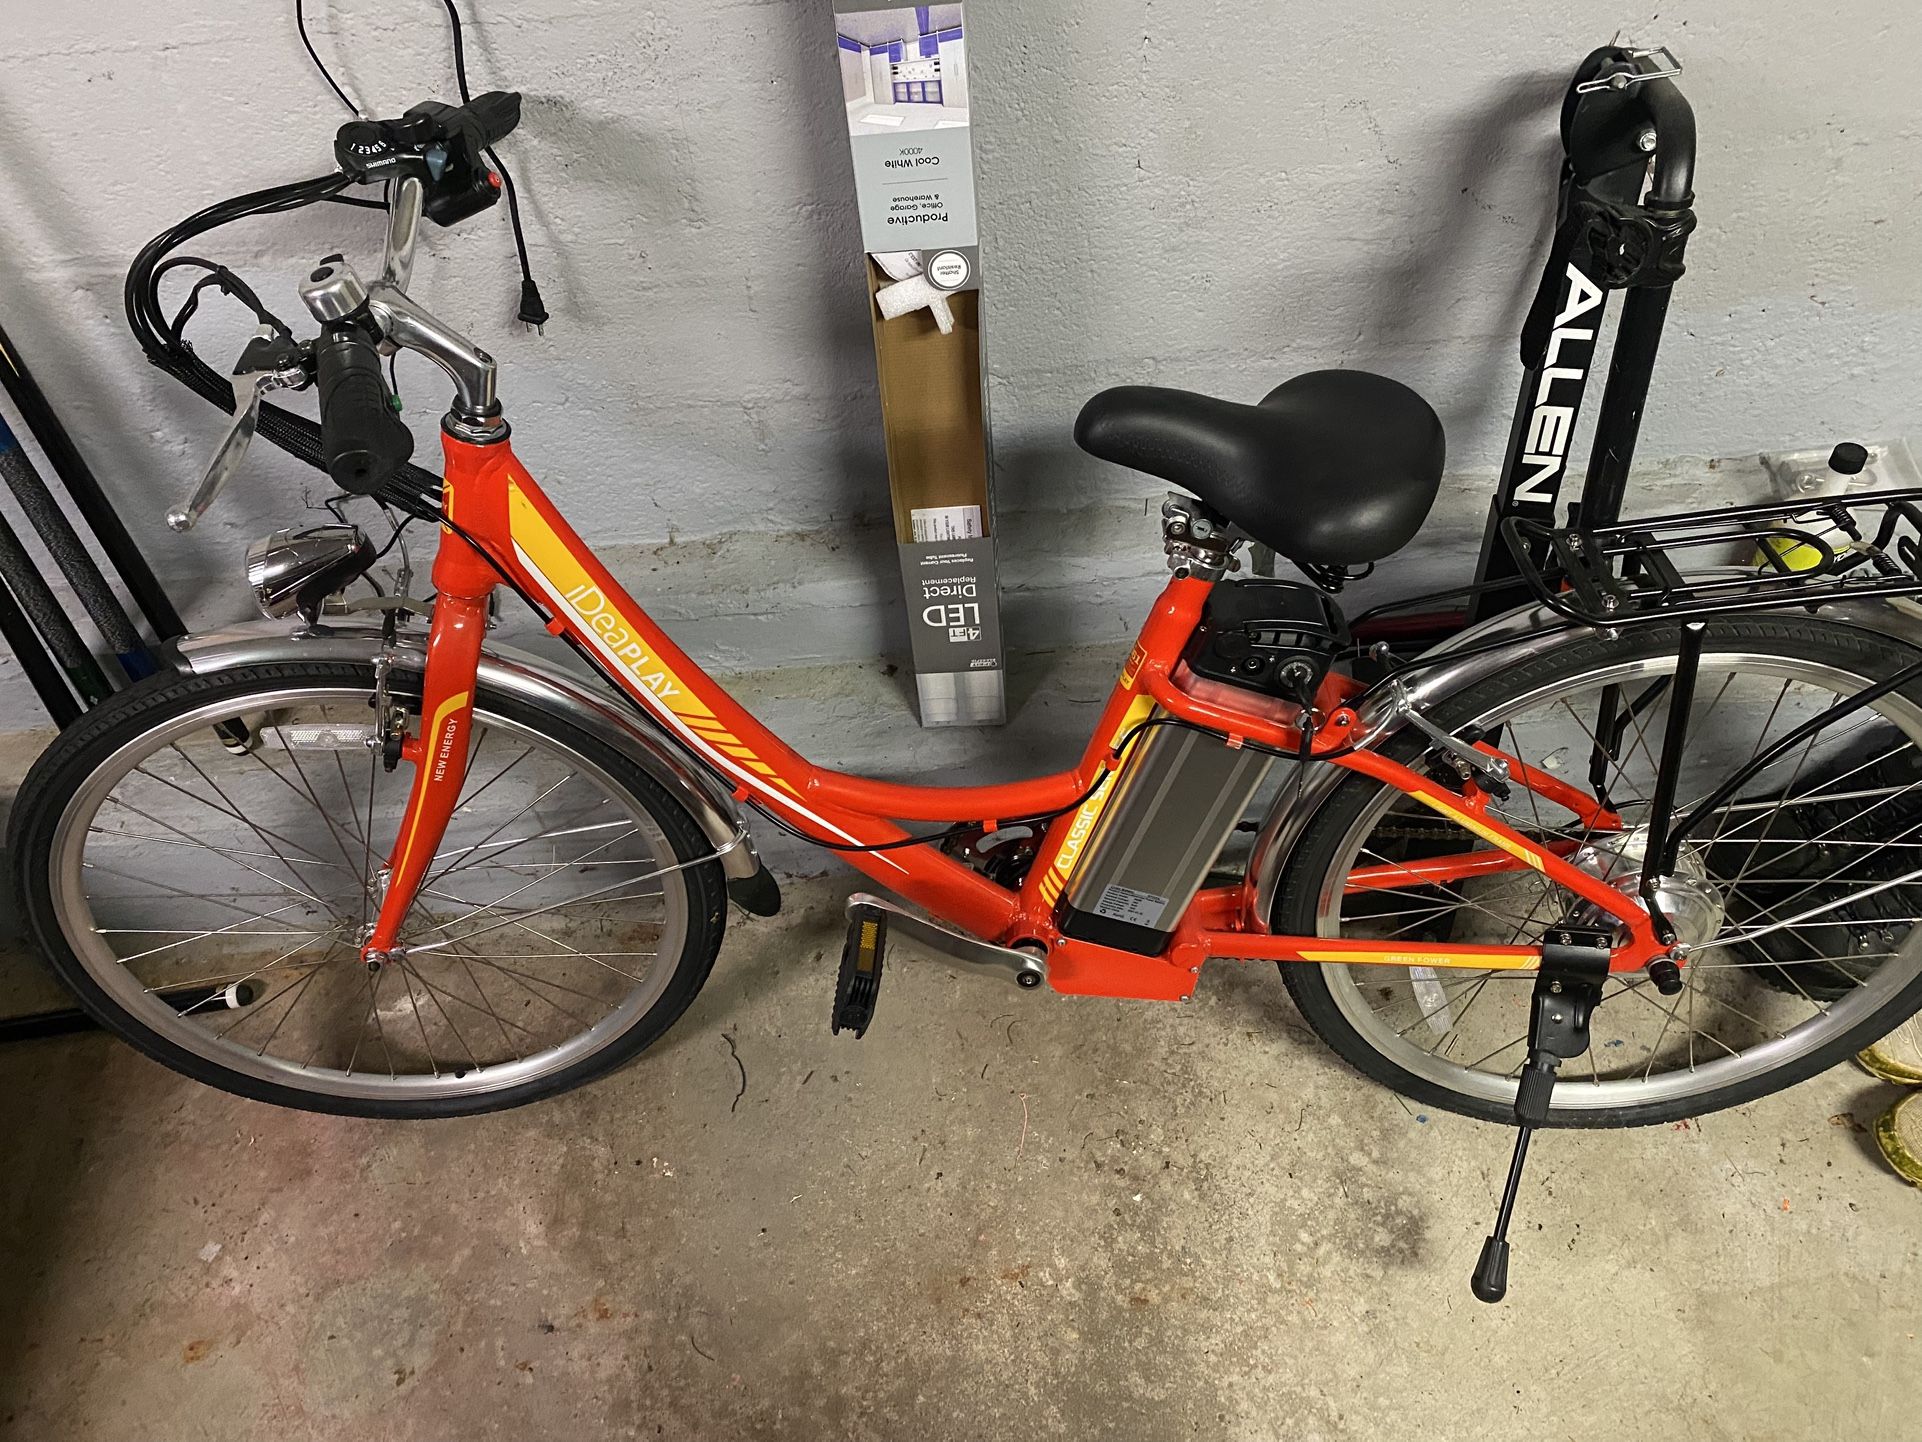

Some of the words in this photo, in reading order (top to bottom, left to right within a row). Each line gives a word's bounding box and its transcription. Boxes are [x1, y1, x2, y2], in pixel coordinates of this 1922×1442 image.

[899, 147, 923, 156] 4000K
[884, 158, 913, 169] White
[916, 156, 940, 167] Cool
[892, 195, 933, 203] Warehouse
[887, 212, 948, 226] Productive
[1513, 262, 1603, 503] ALLEN
[922, 576, 976, 585] Replacement
[923, 584, 976, 599] Direct
[922, 603, 980, 626] LED
[440, 718, 458, 759] ENERGY
[434, 760, 447, 782] NEW
[1056, 804, 1098, 870] CLASSIC
